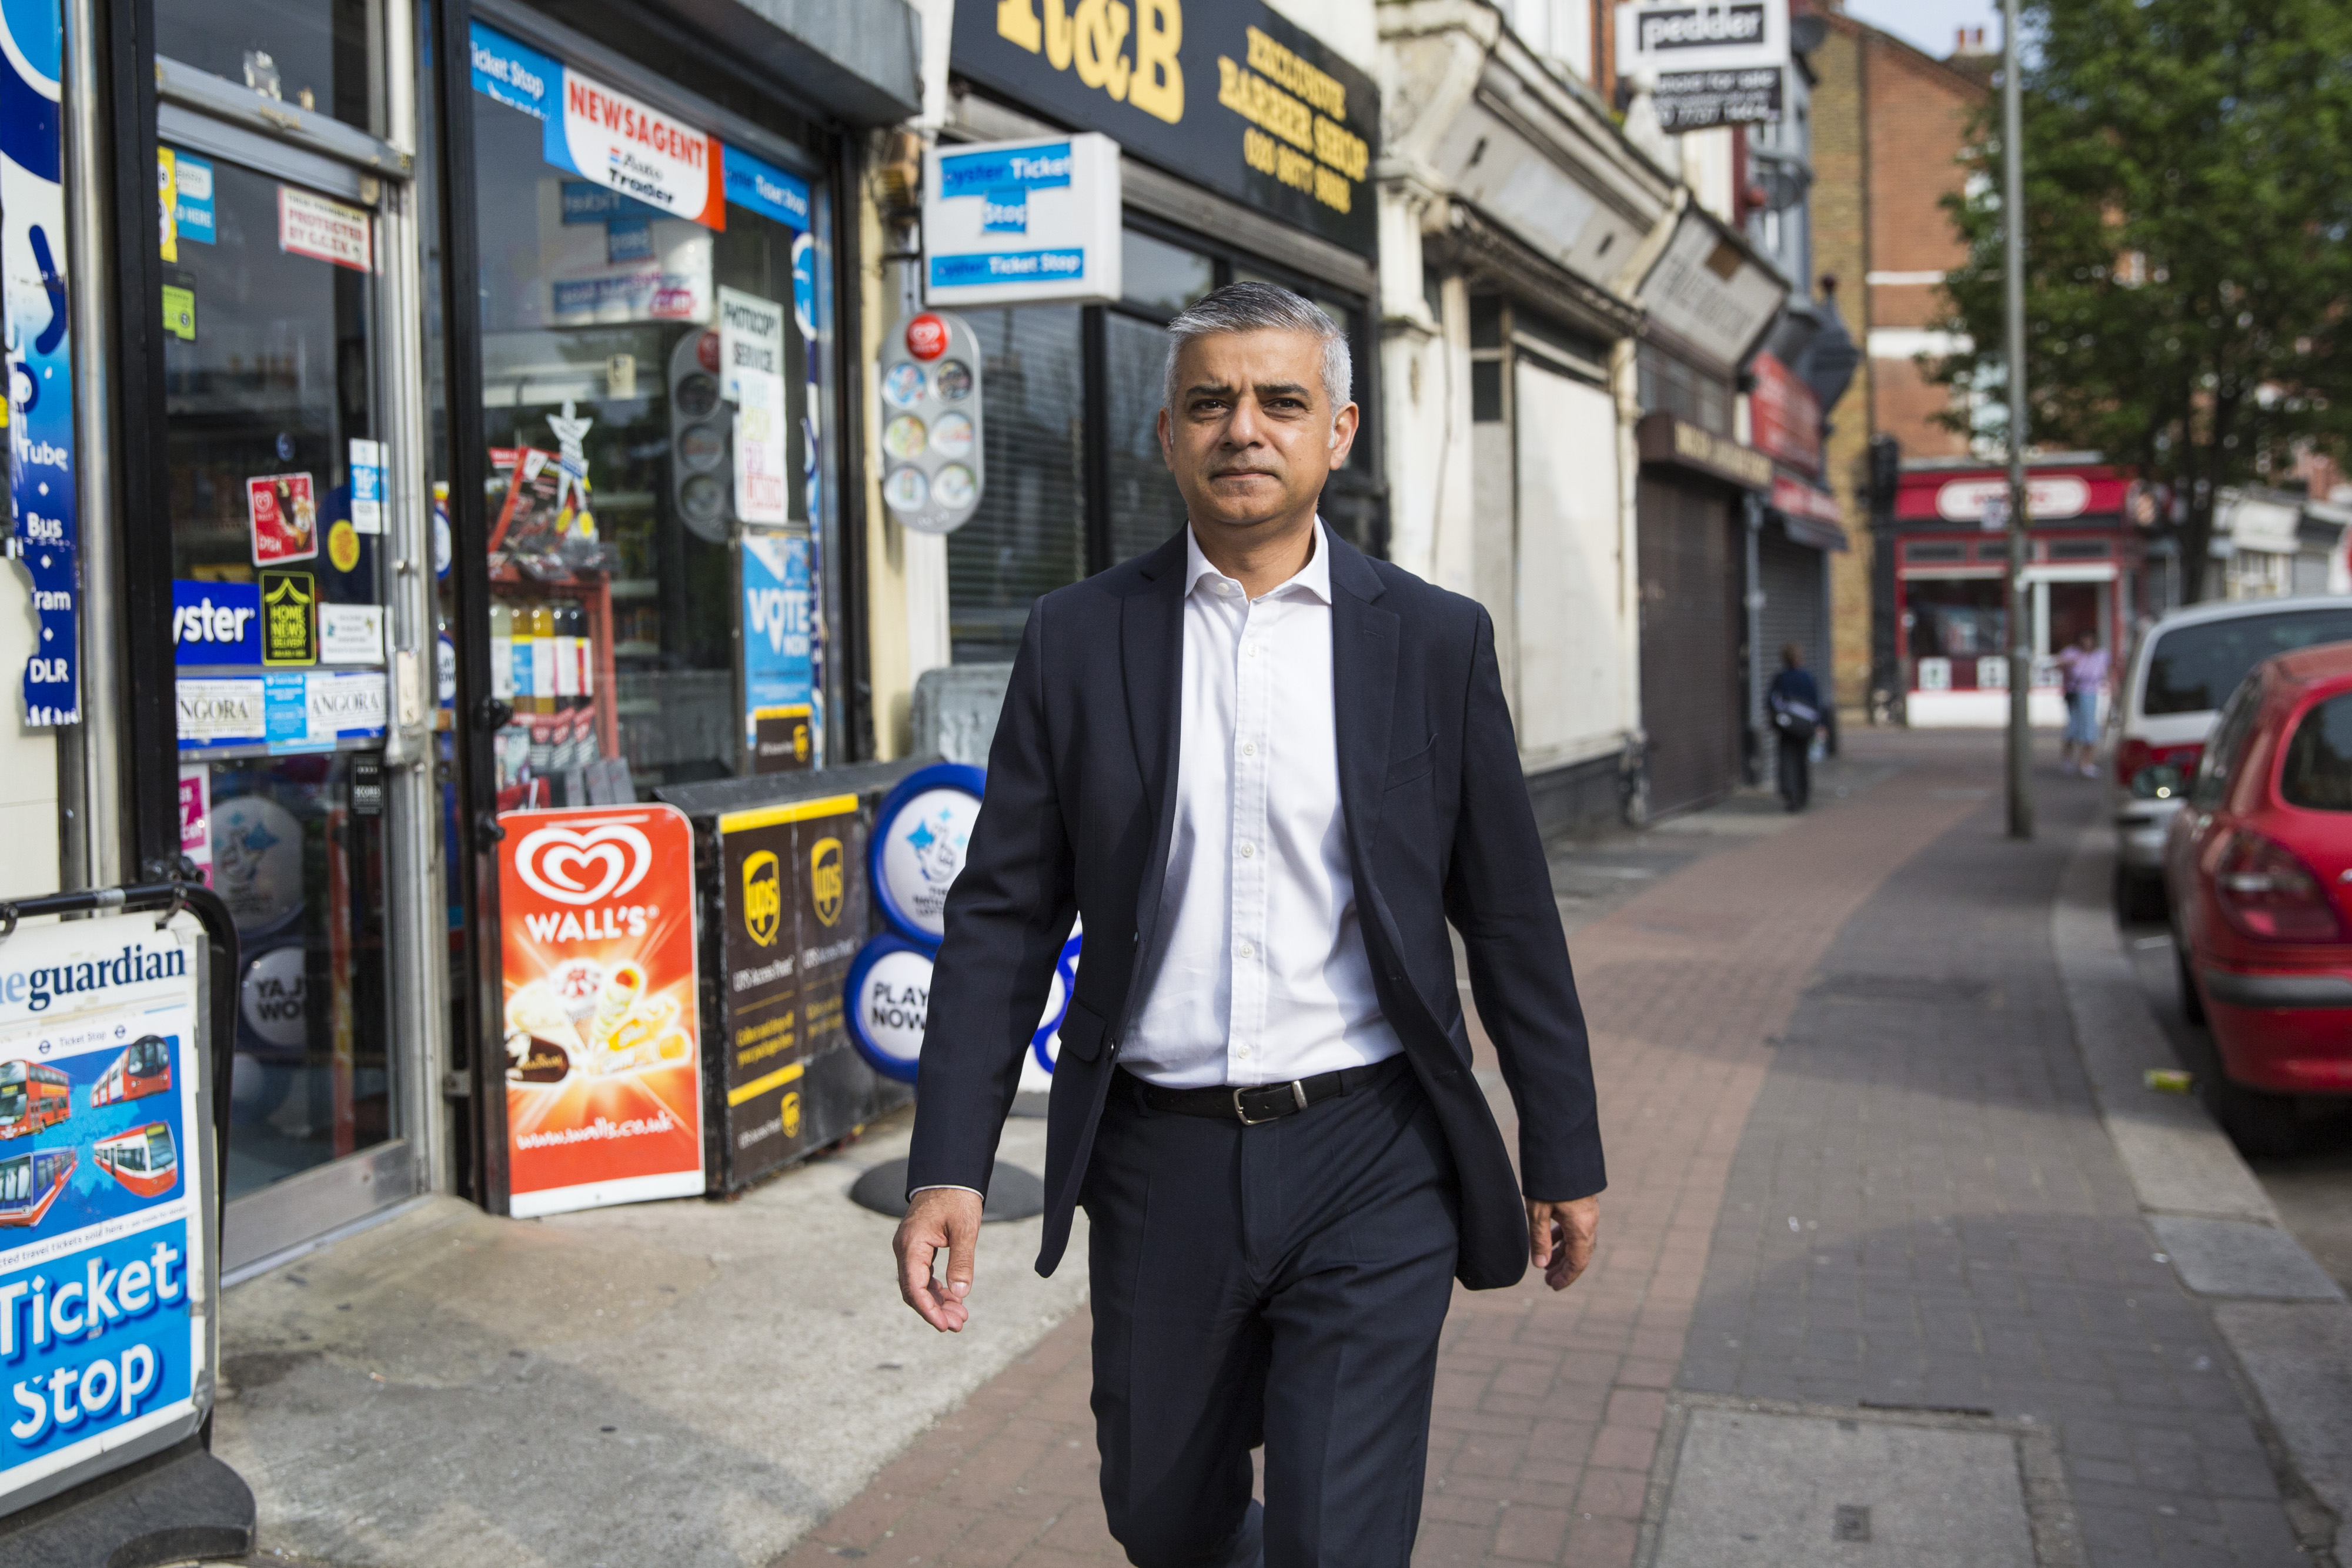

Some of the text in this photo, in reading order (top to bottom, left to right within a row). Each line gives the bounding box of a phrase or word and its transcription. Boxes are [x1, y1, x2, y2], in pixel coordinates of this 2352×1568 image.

[1642, 2, 1761, 49] pedder
[569, 80, 706, 169] NEWSAGENT
[1009, 156, 1071, 180] Ticket
[609, 167, 674, 203] Trader
[289, 208, 363, 243] PROTECTED
[988, 255, 1037, 275] Ticket
[1040, 252, 1082, 274] Stop
[20, 438, 68, 469] Tube
[26, 511, 63, 539] Bus
[32, 590, 71, 611] ram
[270, 605, 305, 621] HOME
[270, 621, 306, 638] NEWS
[746, 587, 810, 646] VOTE
[29, 658, 69, 683] DLR
[312, 692, 380, 716] ANGORA
[524, 905, 647, 943] WALL'S
[873, 982, 930, 1007] PLAY
[871, 1007, 927, 1031] NOW
[59, 1031, 107, 1048] Ticket Stop
[516, 1109, 674, 1150] www.walls.co.uk
[22, 1245, 49, 1260] travel
[52, 1236, 82, 1252] tickets
[85, 1229, 103, 1242] sold
[106, 1223, 124, 1235] here
[0, 1241, 178, 1356] Ticket
[10, 1343, 155, 1440] Stop
